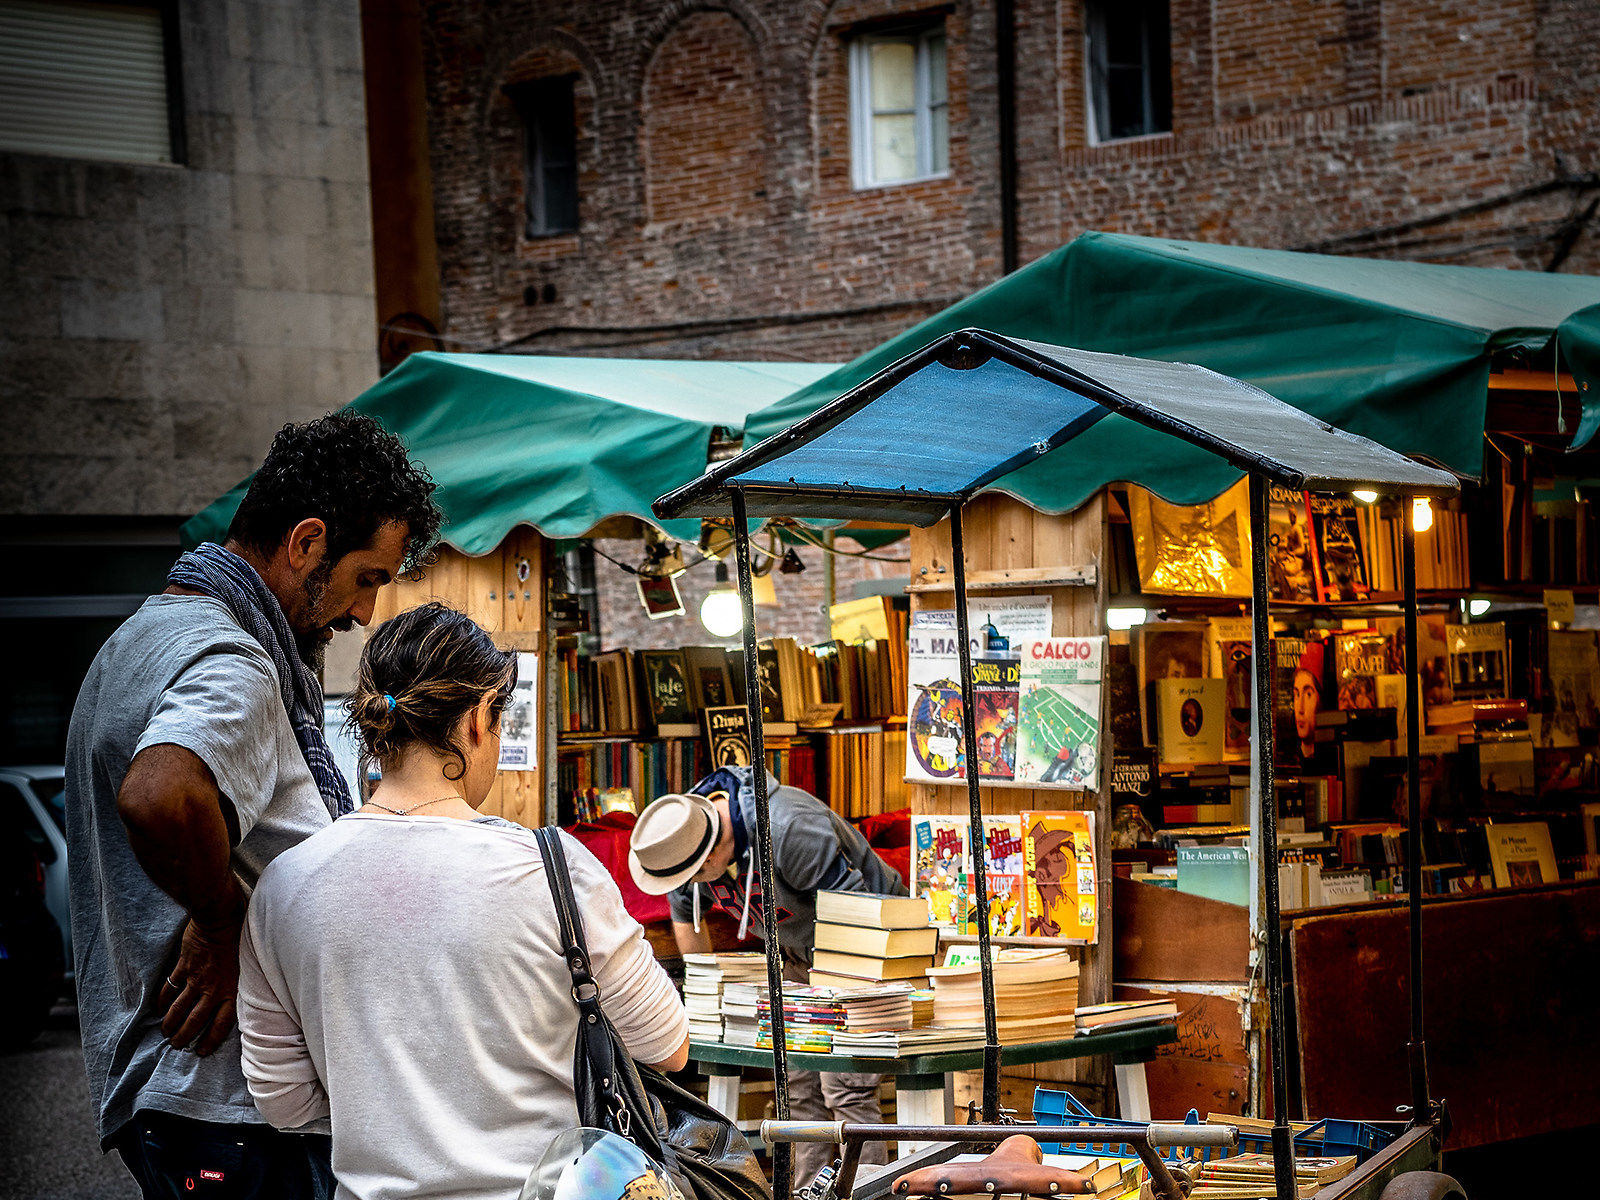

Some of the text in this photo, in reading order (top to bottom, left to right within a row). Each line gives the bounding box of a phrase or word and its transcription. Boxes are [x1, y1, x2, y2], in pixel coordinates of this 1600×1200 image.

[931, 639, 980, 653] MAO
[1031, 641, 1092, 660] CALCIO
[1068, 661, 1099, 670] GRANDE
[1113, 771, 1150, 783] ANTONIO
[1111, 781, 1151, 797] MANZI
[1181, 851, 1196, 861] The
[1197, 851, 1231, 861] American
[1024, 836, 1038, 919] LUCKY LUKE
